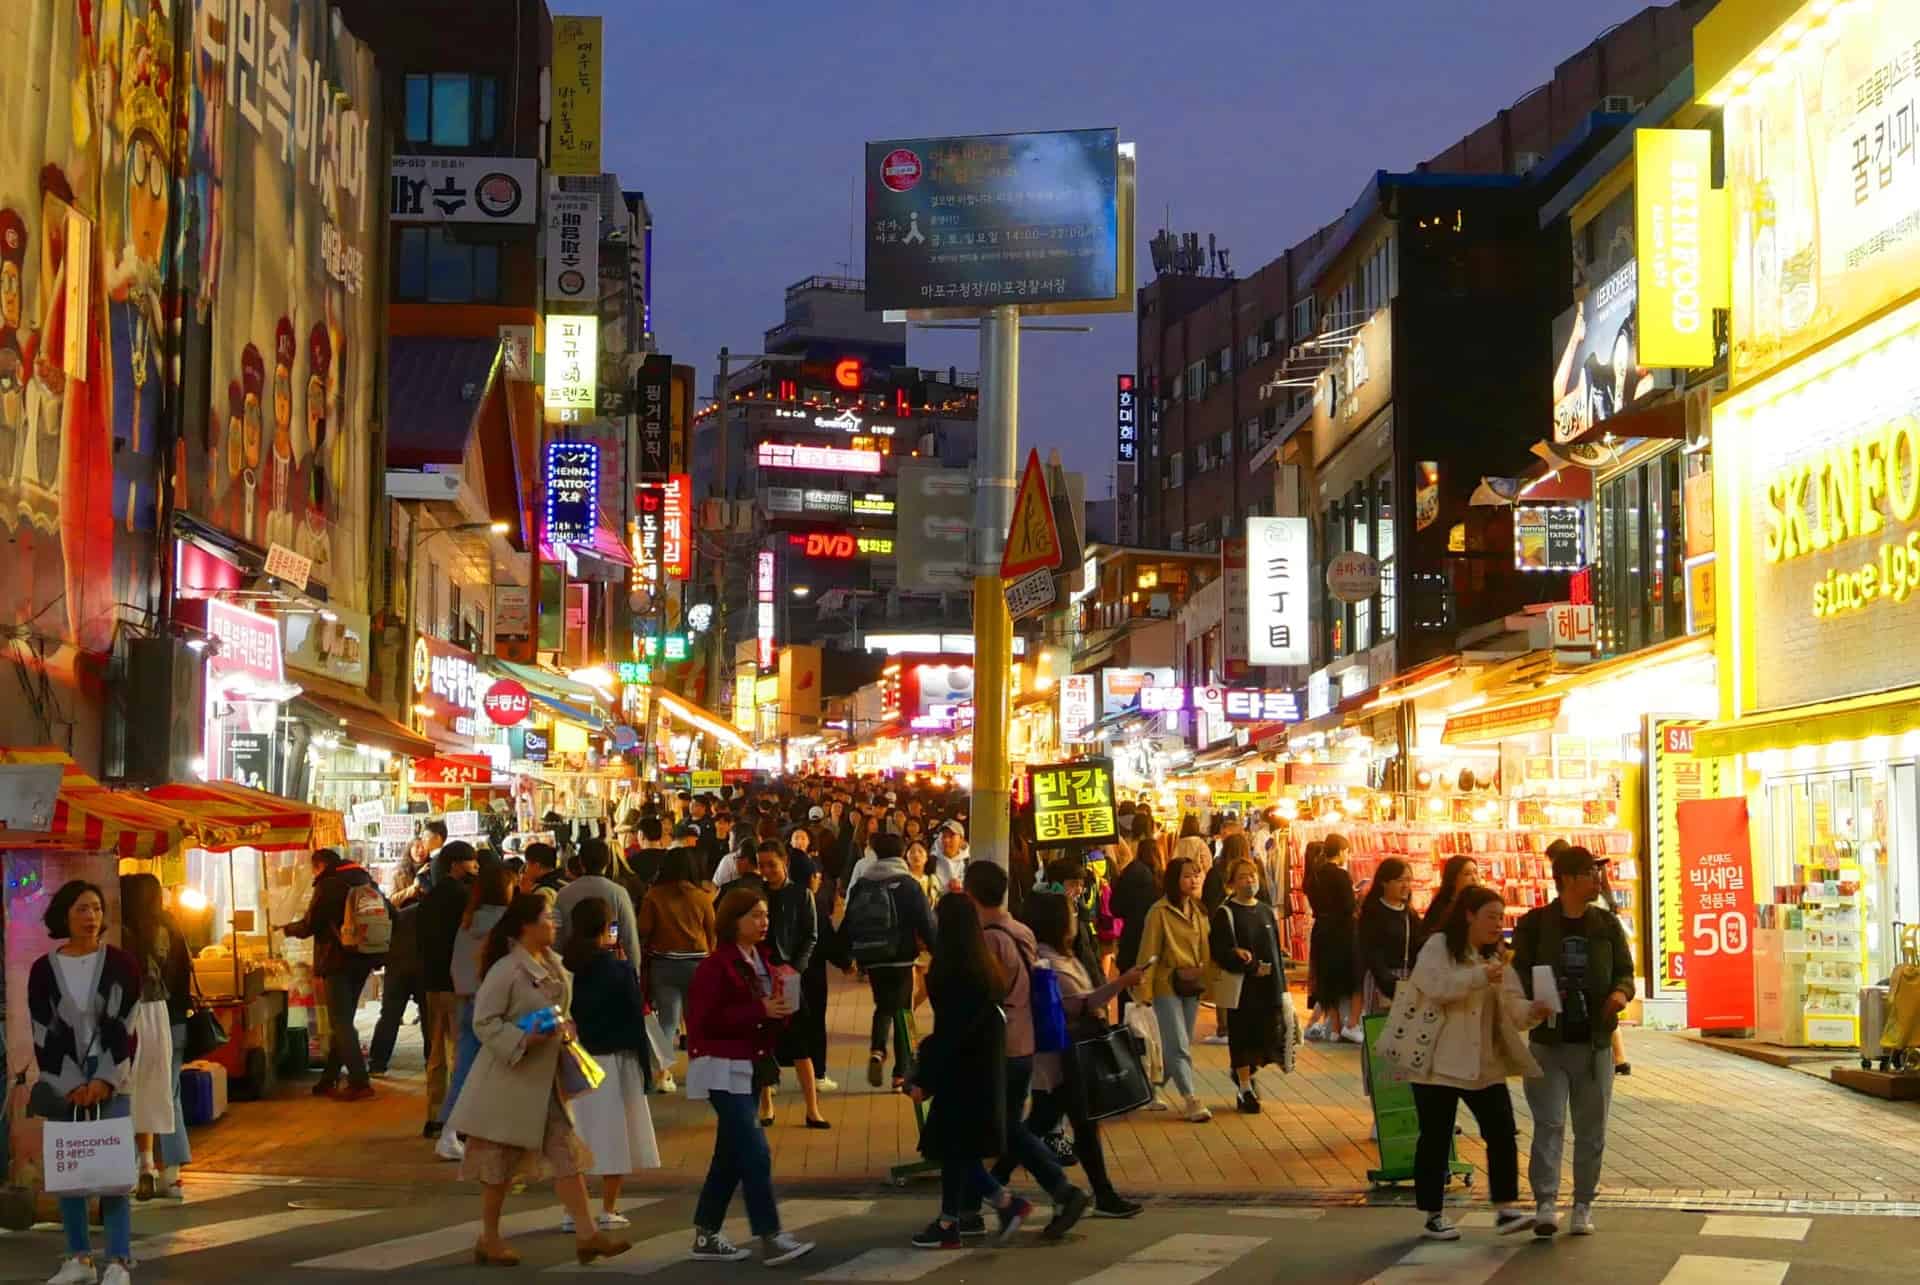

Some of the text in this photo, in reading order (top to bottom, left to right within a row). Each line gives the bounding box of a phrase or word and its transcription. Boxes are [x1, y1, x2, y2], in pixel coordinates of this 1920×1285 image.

[549, 386, 593, 402] 프렌즈
[1119, 392, 1133, 459] 호미화방
[556, 452, 590, 462] ヘンナ
[553, 466, 590, 476] HENNA
[558, 491, 581, 503] 文身
[806, 534, 854, 557] DVD
[857, 538, 893, 553] 영화관
[1812, 562, 1880, 618] since
[1267, 558, 1290, 649] 三丁目
[1558, 607, 1594, 641] 헤나
[487, 694, 526, 711] 부동산
[1227, 691, 1299, 719] 타로
[1670, 730, 1693, 750] SAL
[440, 766, 477, 783] 성신
[1034, 768, 1109, 807] 반값
[1039, 809, 1109, 837] 방탈출
[1699, 854, 1733, 865] 스킨푸드
[1690, 866, 1745, 891] 빅세일
[1699, 893, 1737, 909] 전품목
[55, 1136, 121, 1148] 8 seconds
[55, 1148, 96, 1160] 8 세컨즈
[56, 1161, 65, 1172] 8
